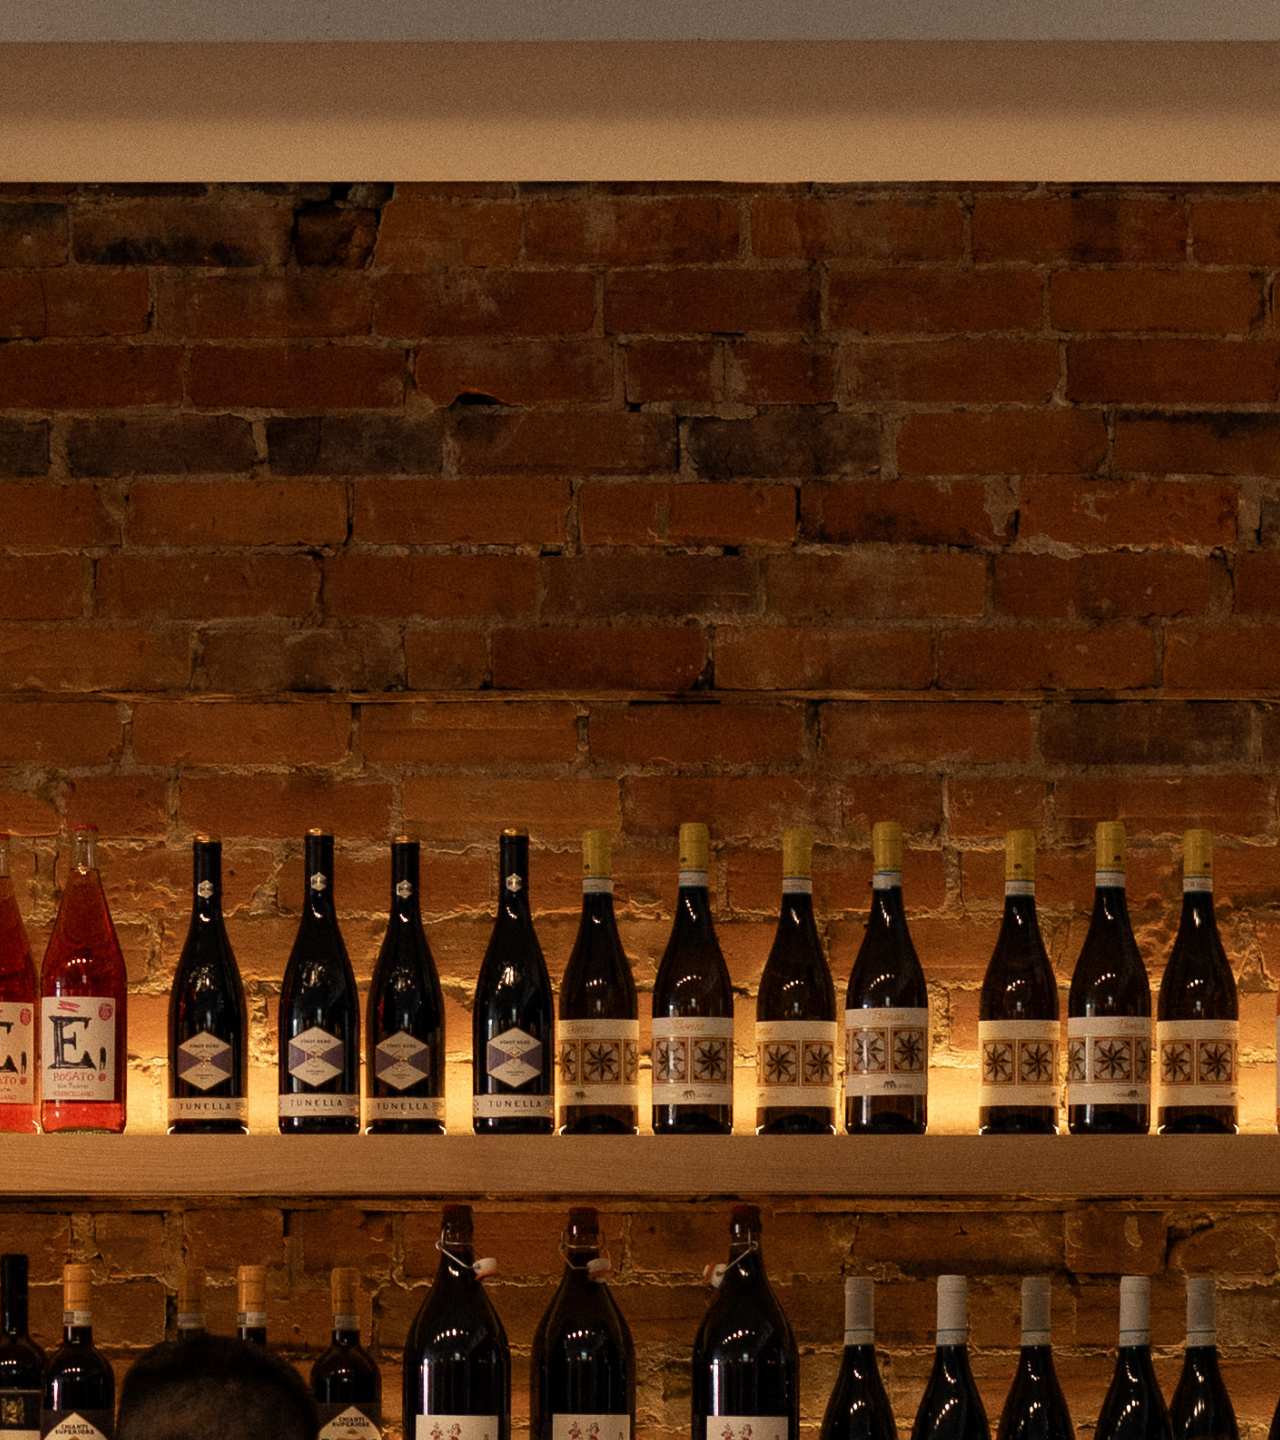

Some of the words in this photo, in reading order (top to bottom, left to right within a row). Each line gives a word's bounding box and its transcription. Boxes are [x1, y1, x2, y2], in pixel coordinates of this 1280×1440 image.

[53, 1071, 95, 1081] ROSATO
[179, 1103, 231, 1111] TUNELLA
[290, 1099, 343, 1107] TUNELLA
[376, 1102, 428, 1110] TUNELLA
[488, 1100, 542, 1108] TUNELLA
